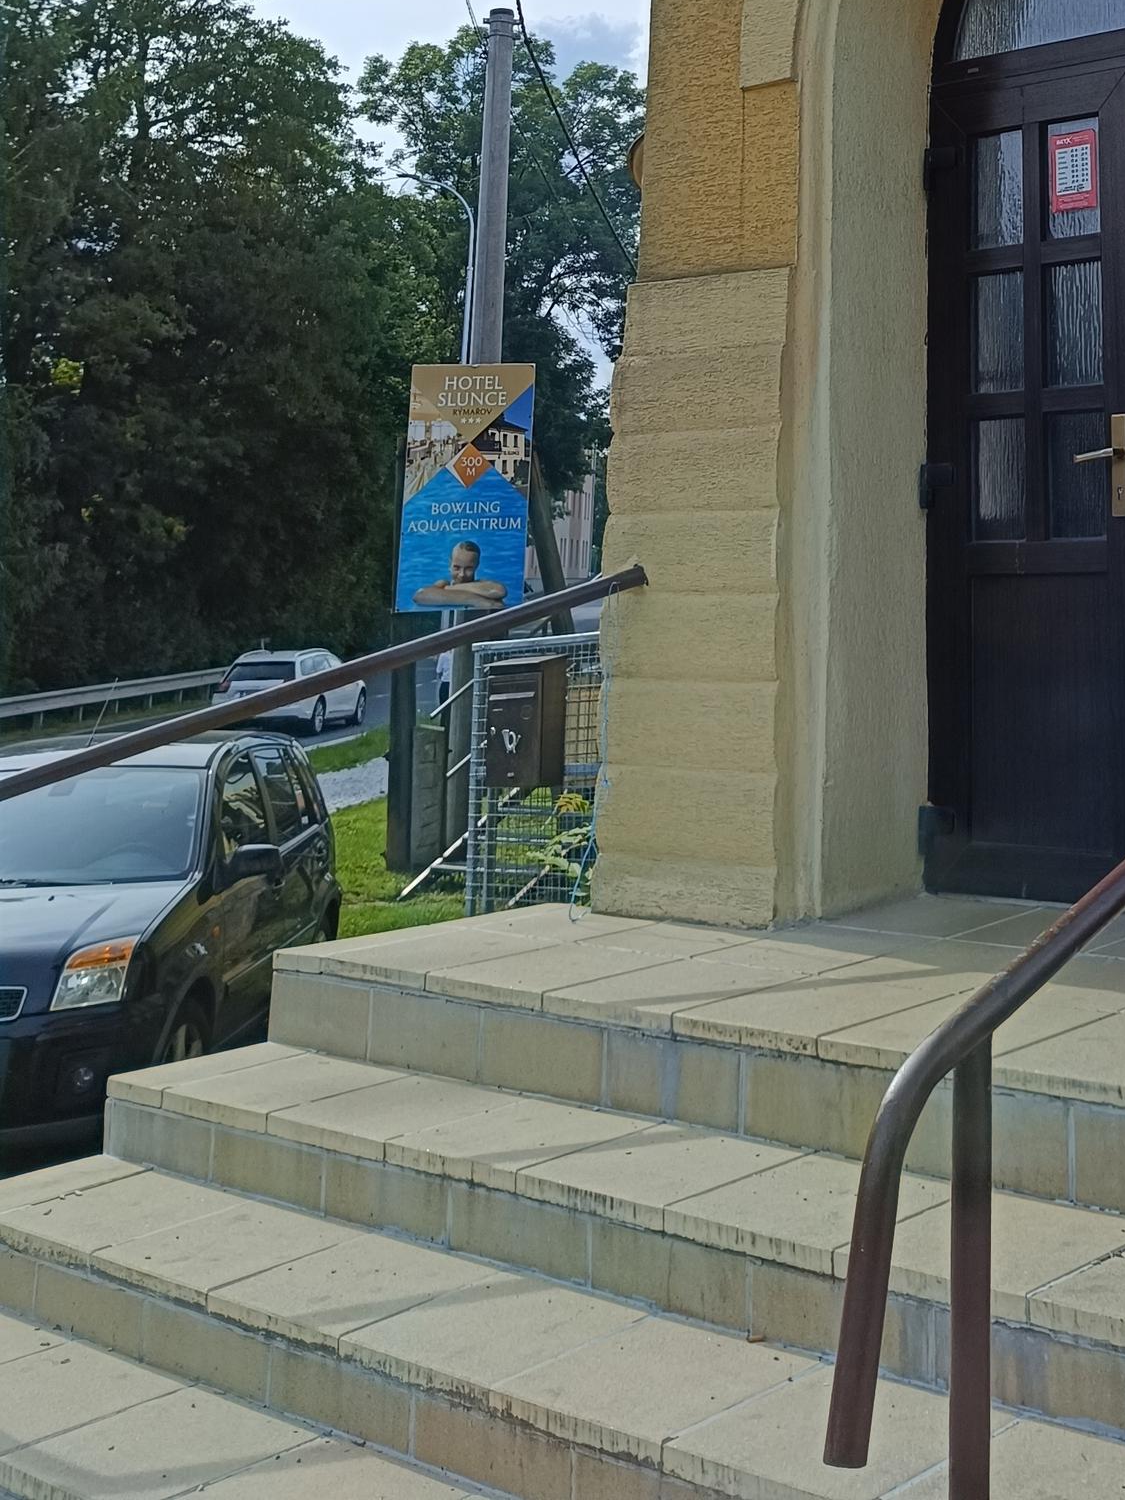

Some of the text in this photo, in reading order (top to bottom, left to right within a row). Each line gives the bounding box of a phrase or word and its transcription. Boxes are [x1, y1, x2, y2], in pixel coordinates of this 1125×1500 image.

[444, 375, 503, 390] HOTEL
[437, 391, 507, 407] SLUNCE
[452, 407, 493, 416] RÝMAŘOV
[460, 456, 483, 467] 300
[466, 467, 476, 477] M
[431, 501, 501, 515] BOWLING
[407, 516, 522, 533] AQUACENTRUM
